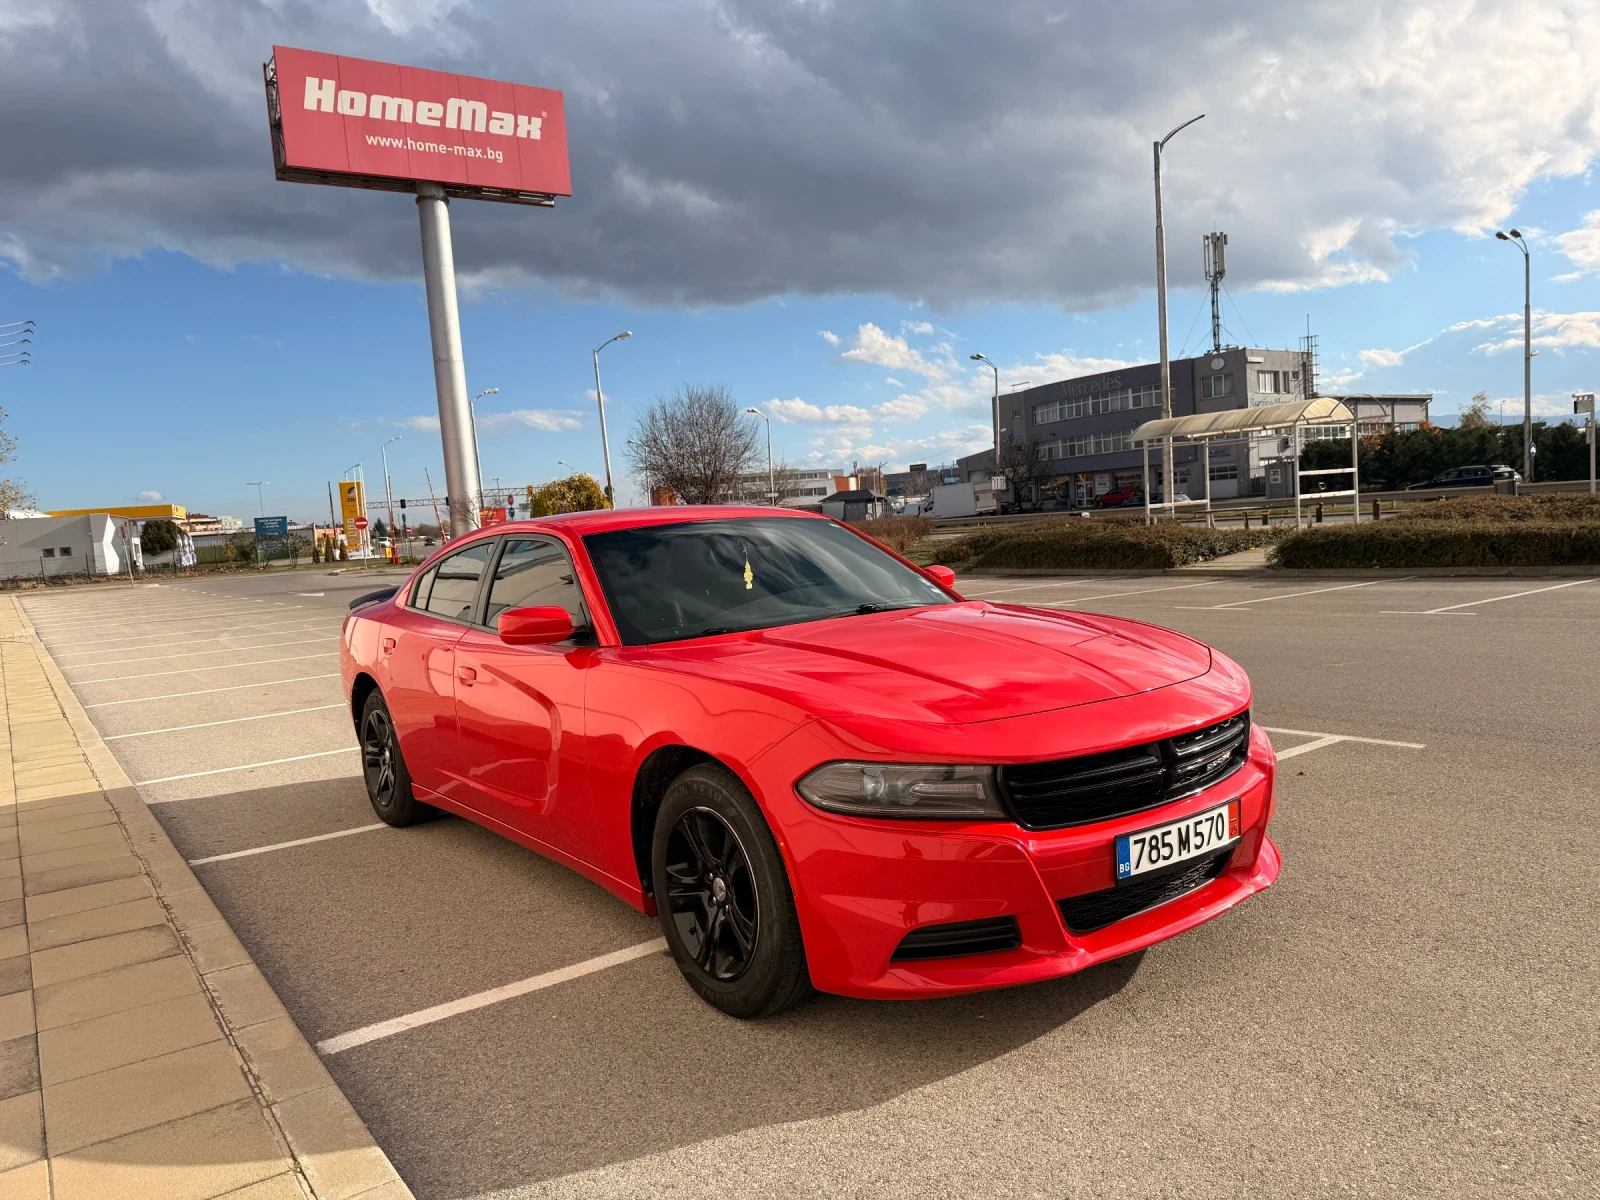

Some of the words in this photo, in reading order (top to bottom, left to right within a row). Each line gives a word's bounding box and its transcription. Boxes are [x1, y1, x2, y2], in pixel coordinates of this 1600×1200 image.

[303, 76, 542, 139] HomeMax
[365, 134, 504, 164] www.home-max.bg
[1061, 375, 1122, 398] Mercedes
[1120, 862, 1130, 873] BG
